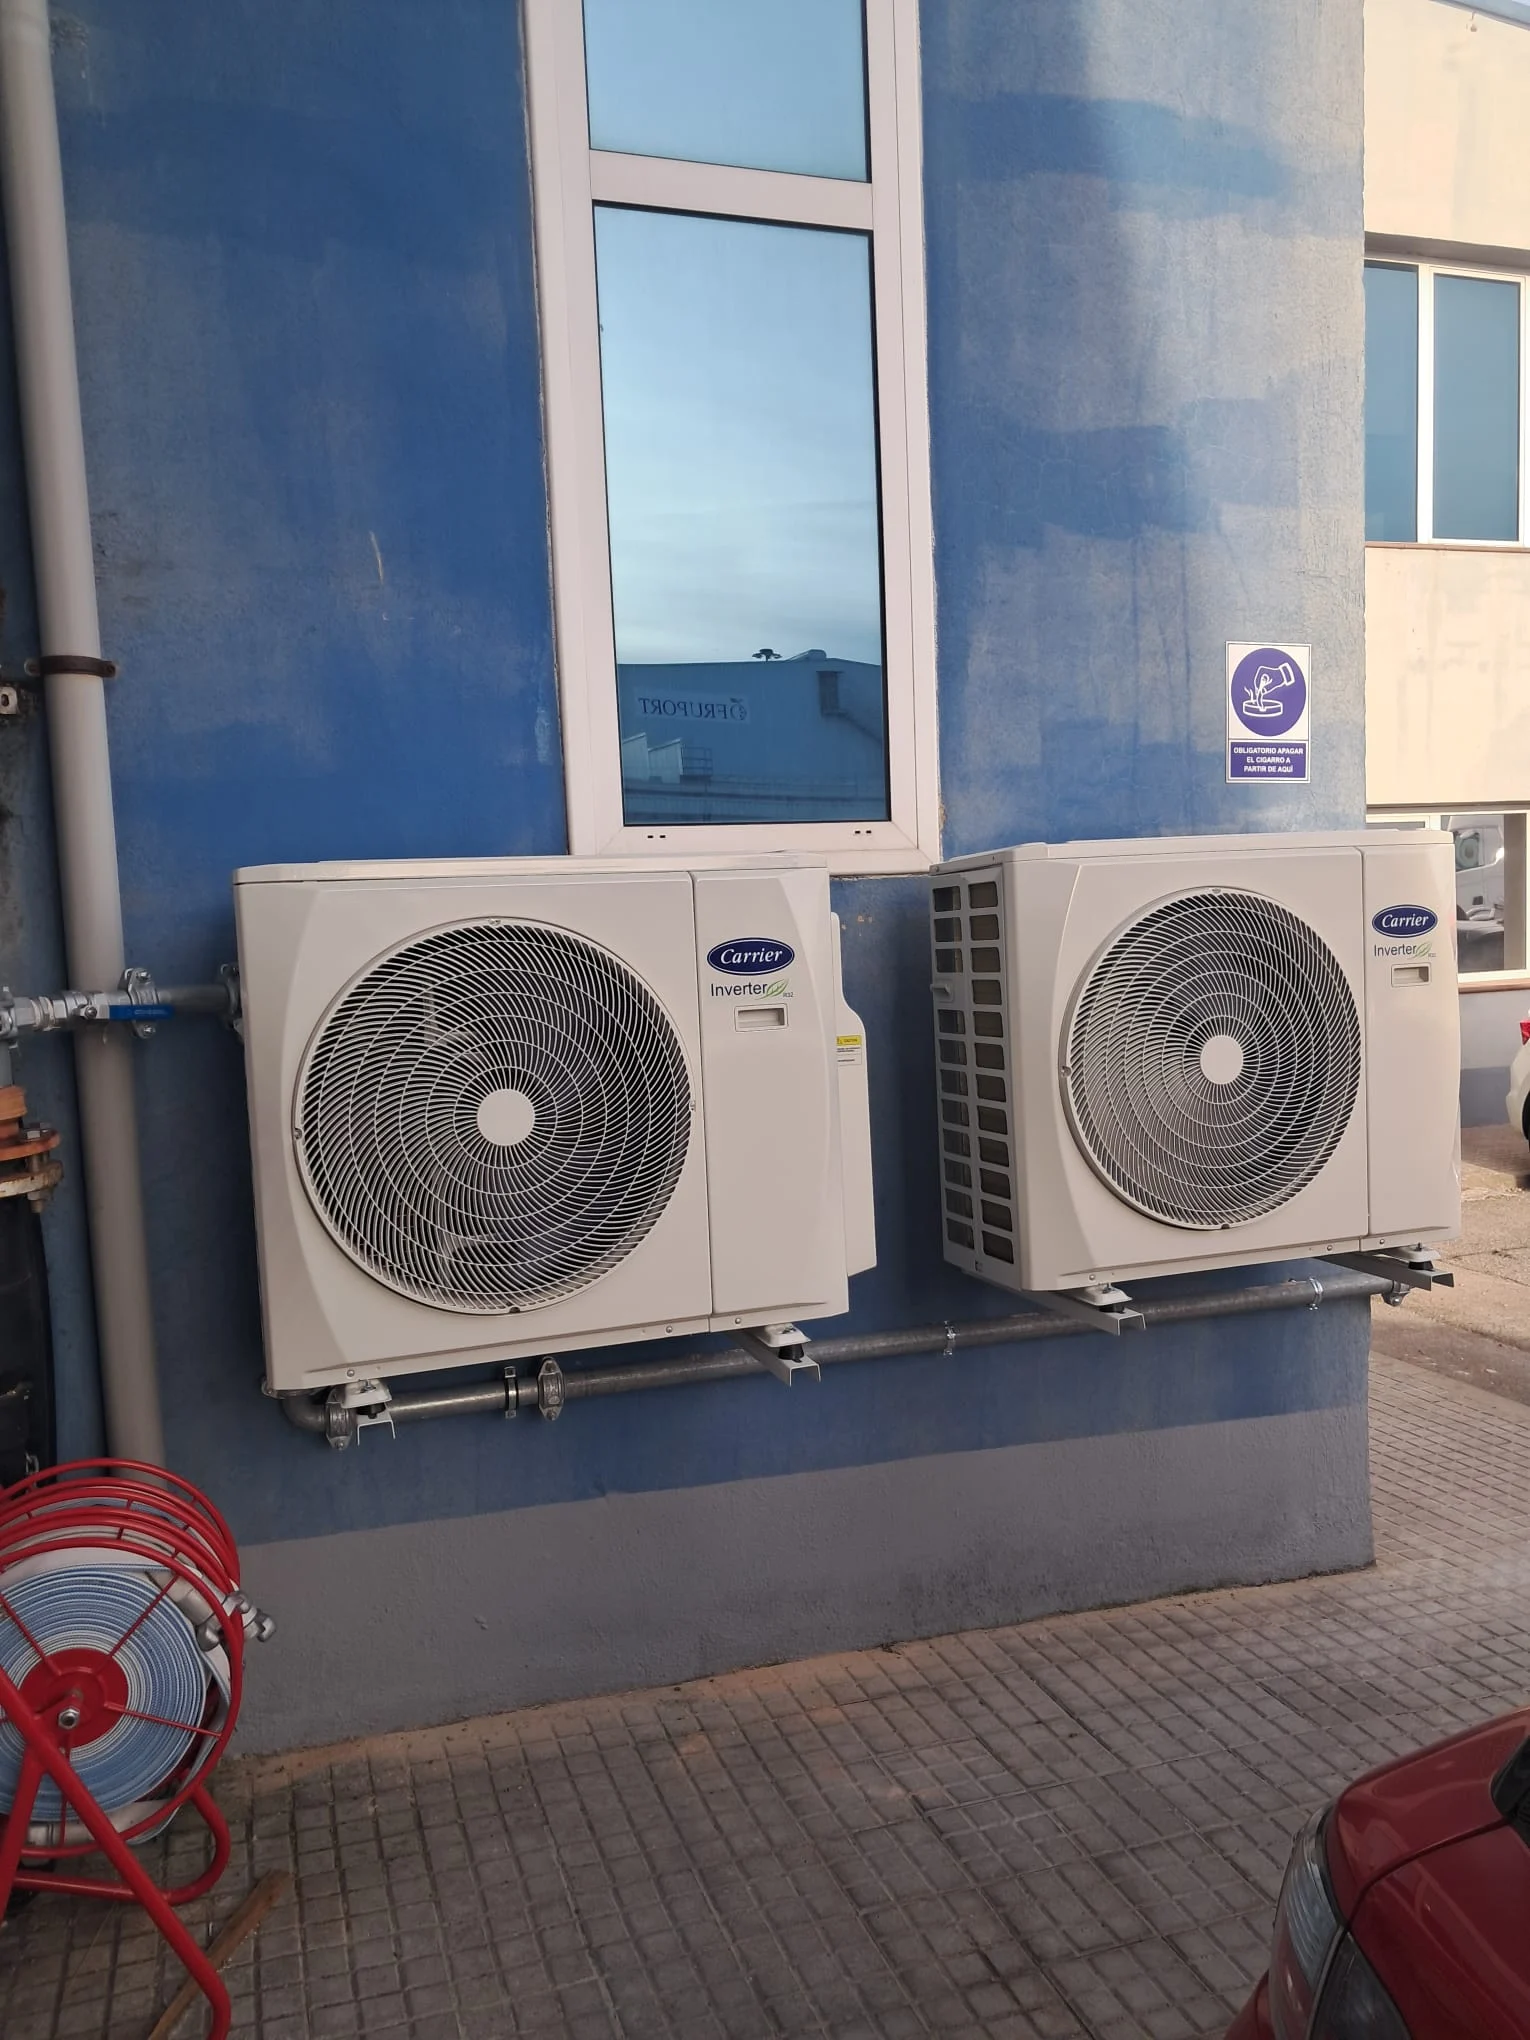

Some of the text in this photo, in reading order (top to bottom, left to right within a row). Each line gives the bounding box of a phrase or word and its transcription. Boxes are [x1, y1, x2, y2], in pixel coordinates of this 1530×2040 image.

[1277, 747, 1303, 755] APAGAR
[1243, 765, 1267, 773] PARTIR
[1277, 764, 1293, 773] AQUÍ
[1383, 914, 1429, 928] Carrier
[720, 948, 782, 964] Carrier
[1374, 944, 1416, 957] Inverter
[711, 982, 767, 997] Inverter
